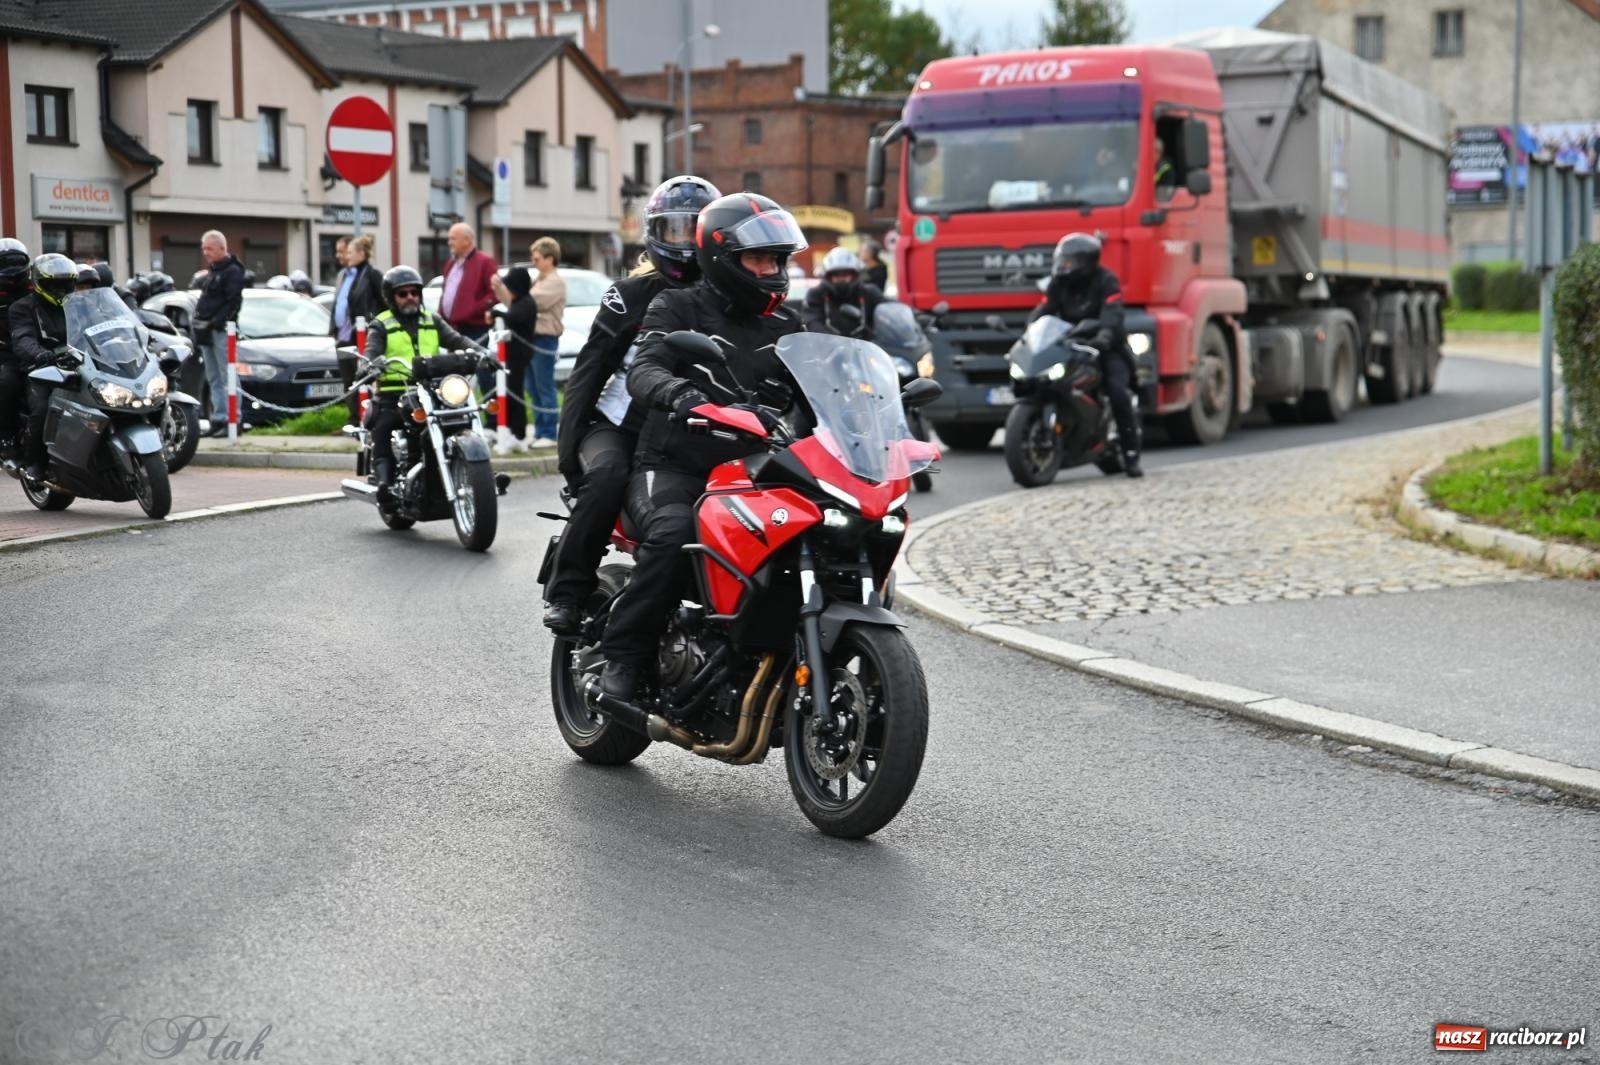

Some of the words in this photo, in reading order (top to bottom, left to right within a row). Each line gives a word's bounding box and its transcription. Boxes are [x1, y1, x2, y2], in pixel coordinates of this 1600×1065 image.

[976, 59, 1075, 86] PAKOS
[52, 180, 110, 203] dentica
[982, 253, 1044, 269] MAN
